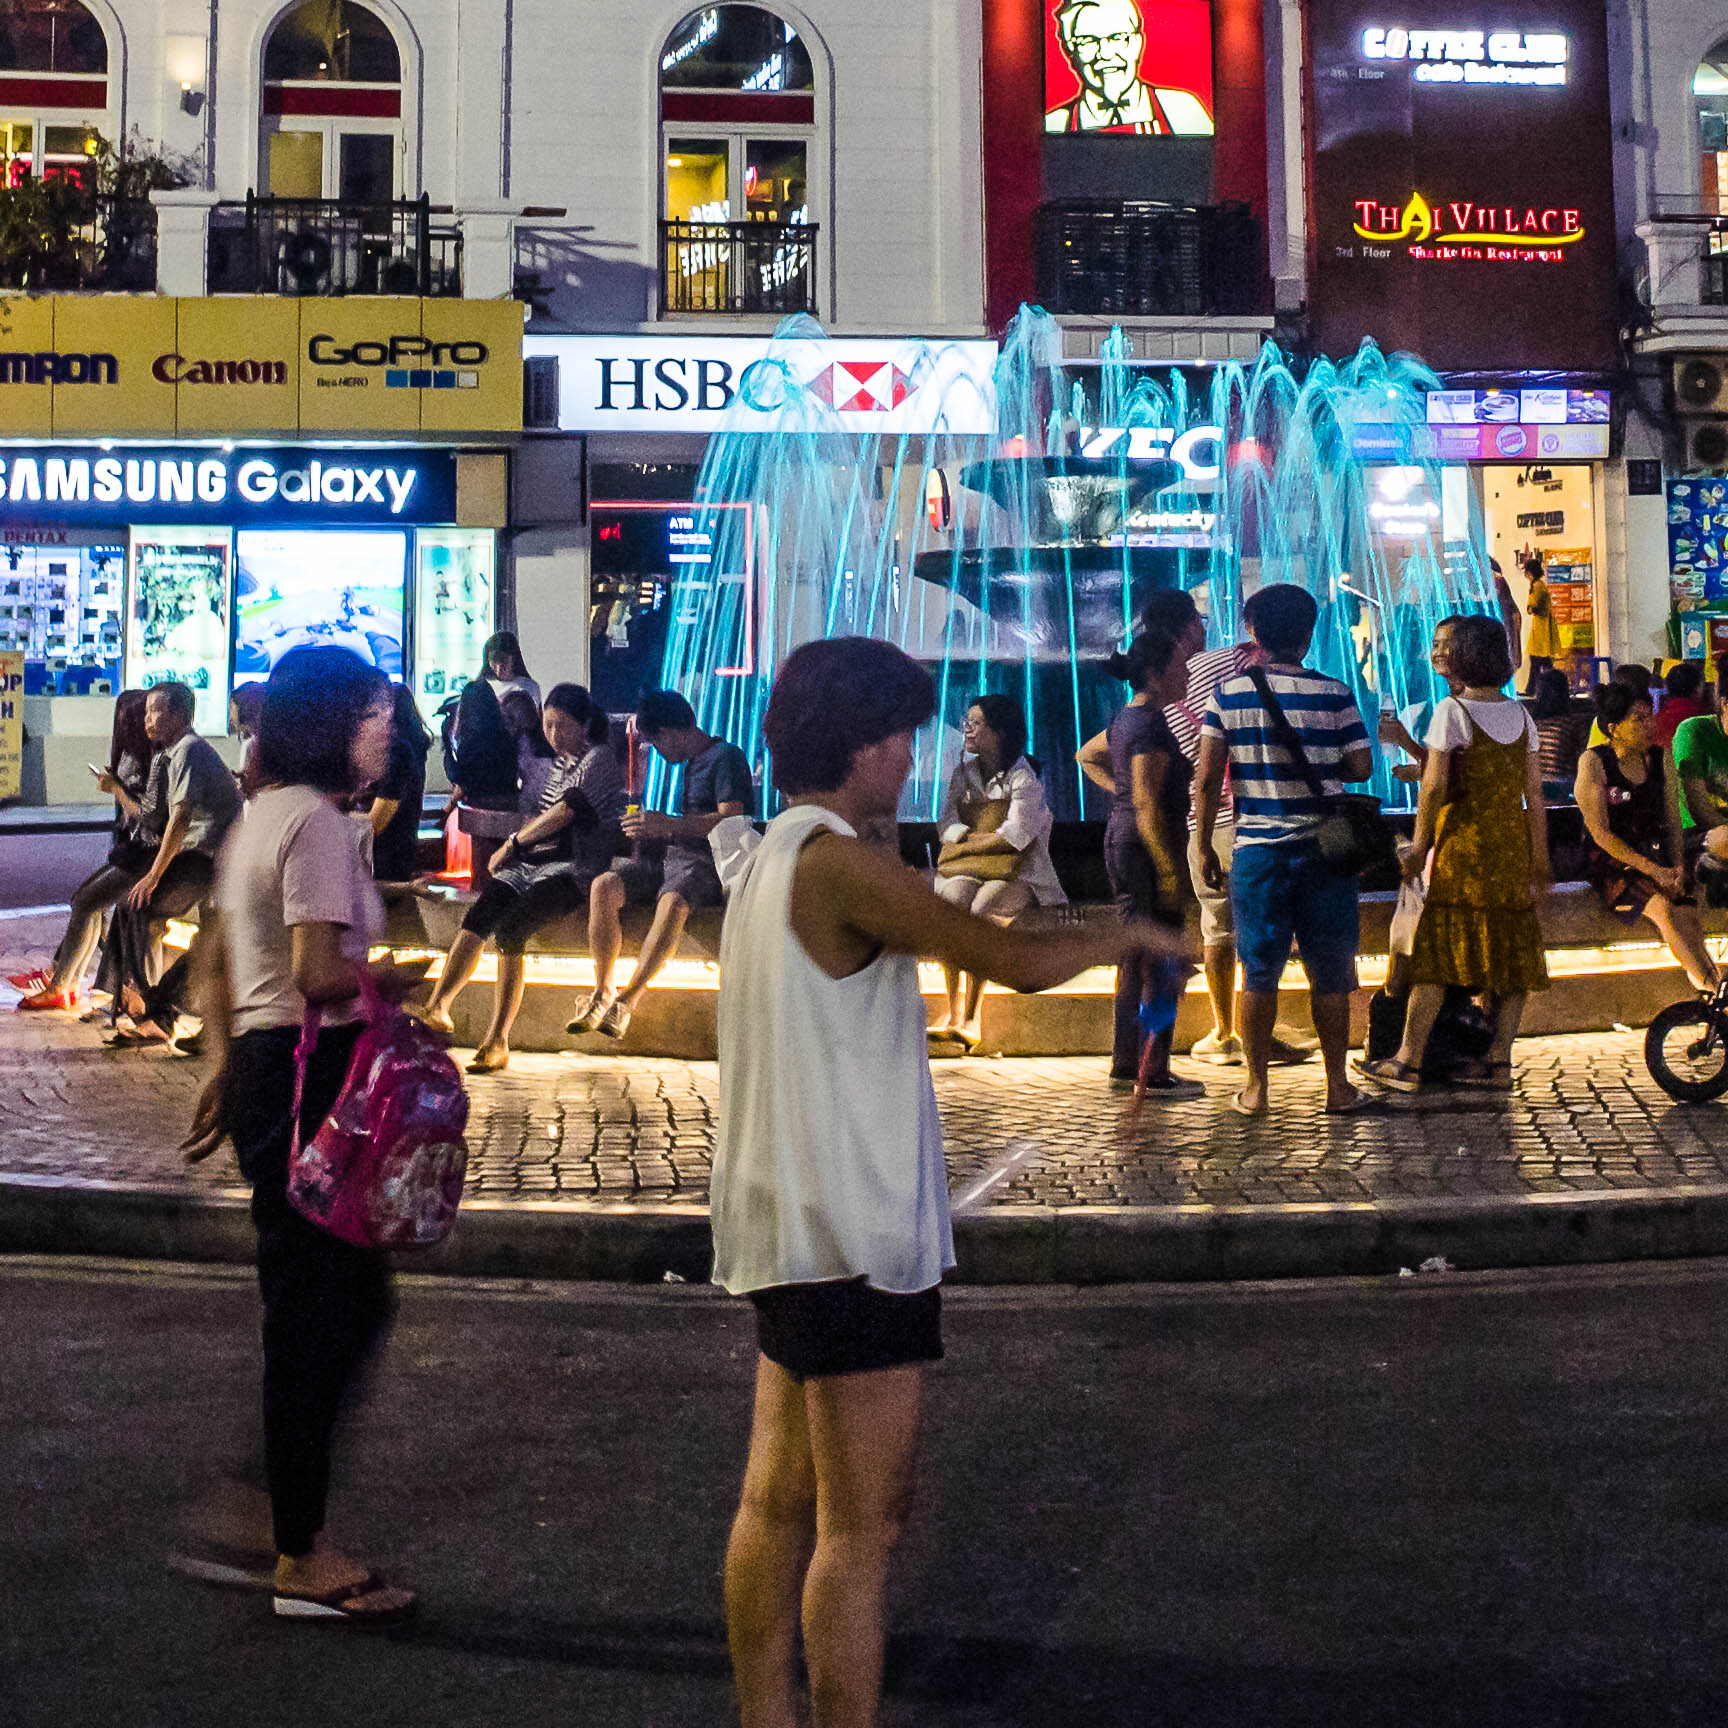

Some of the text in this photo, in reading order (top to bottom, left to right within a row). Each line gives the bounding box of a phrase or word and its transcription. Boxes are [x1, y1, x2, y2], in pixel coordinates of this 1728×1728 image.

[1354, 191, 1442, 242] THAI
[1363, 246, 1392, 259] Floor
[308, 333, 489, 367] GoPro
[152, 353, 289, 386] Canon
[594, 357, 789, 413] HSBC
[237, 457, 417, 515] Galaxy
[669, 517, 694, 530] ATM
[1125, 509, 1217, 531] Kentucky
[4, 530, 68, 544] PENTAX
